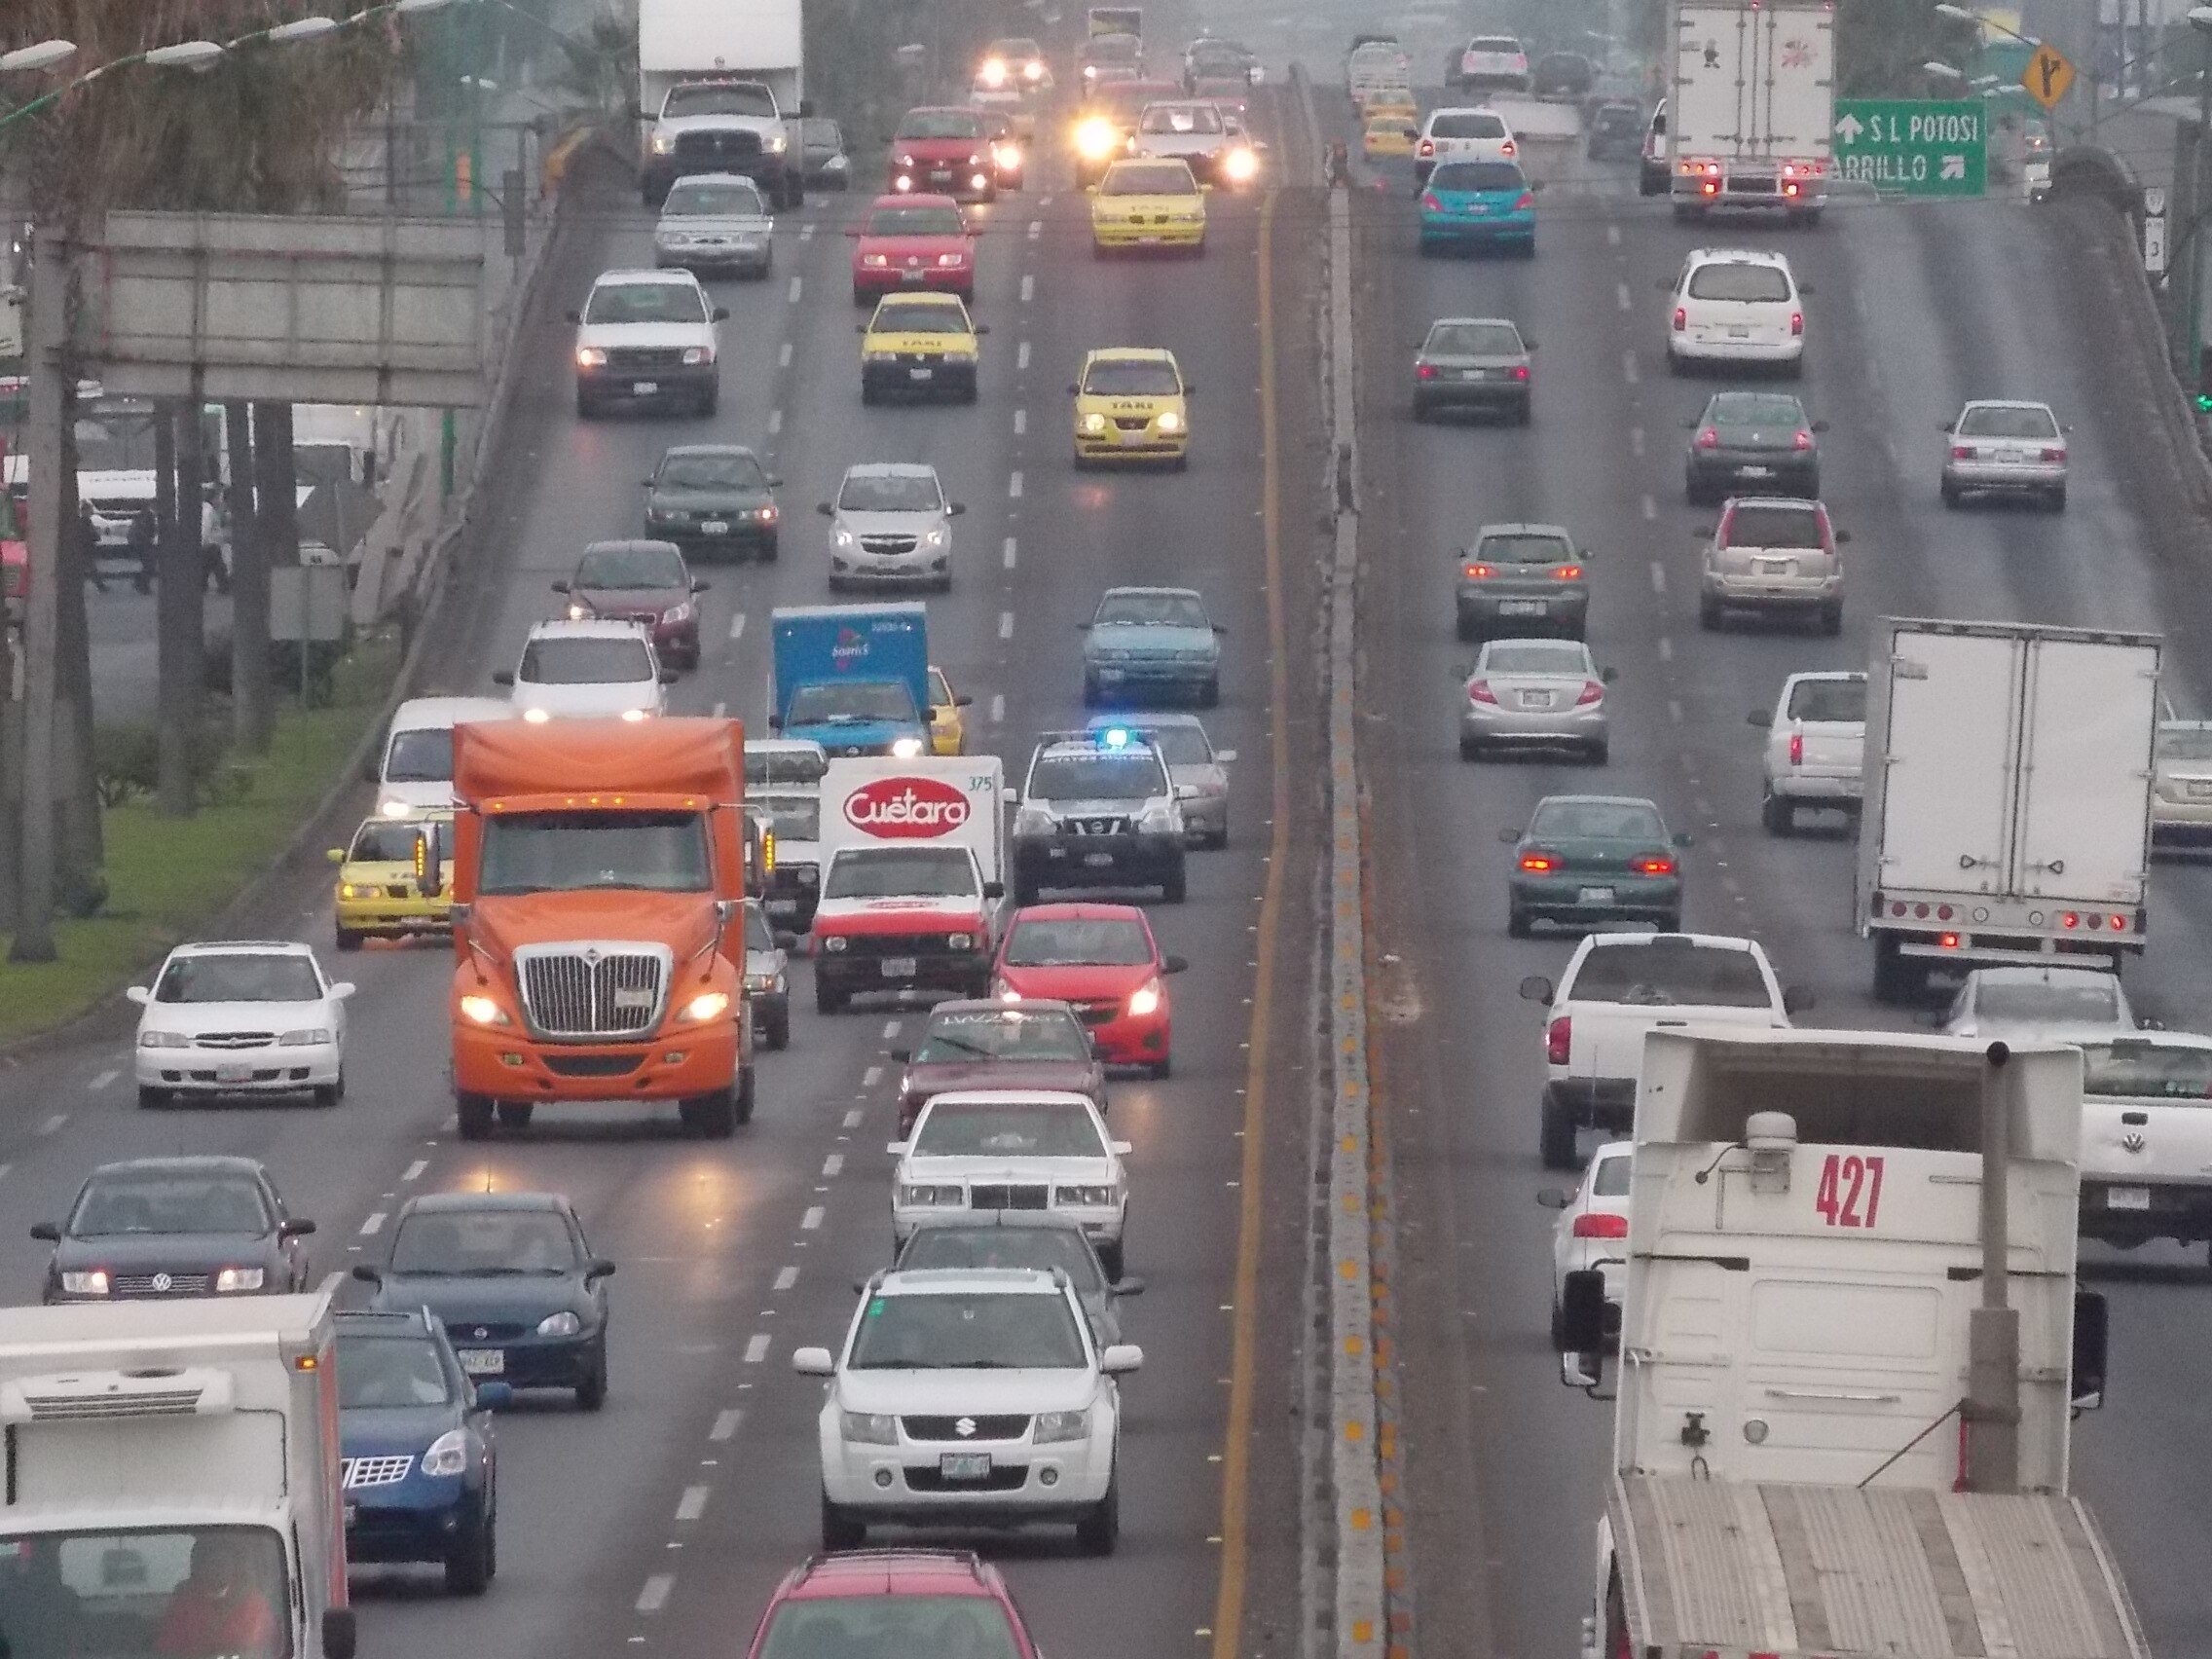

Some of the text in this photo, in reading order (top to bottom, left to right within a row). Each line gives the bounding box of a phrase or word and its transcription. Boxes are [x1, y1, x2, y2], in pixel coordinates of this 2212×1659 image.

[1870, 114, 1978, 142] S L POTOSI
[968, 776, 992, 792] 375
[1817, 1155, 1884, 1228] 427
